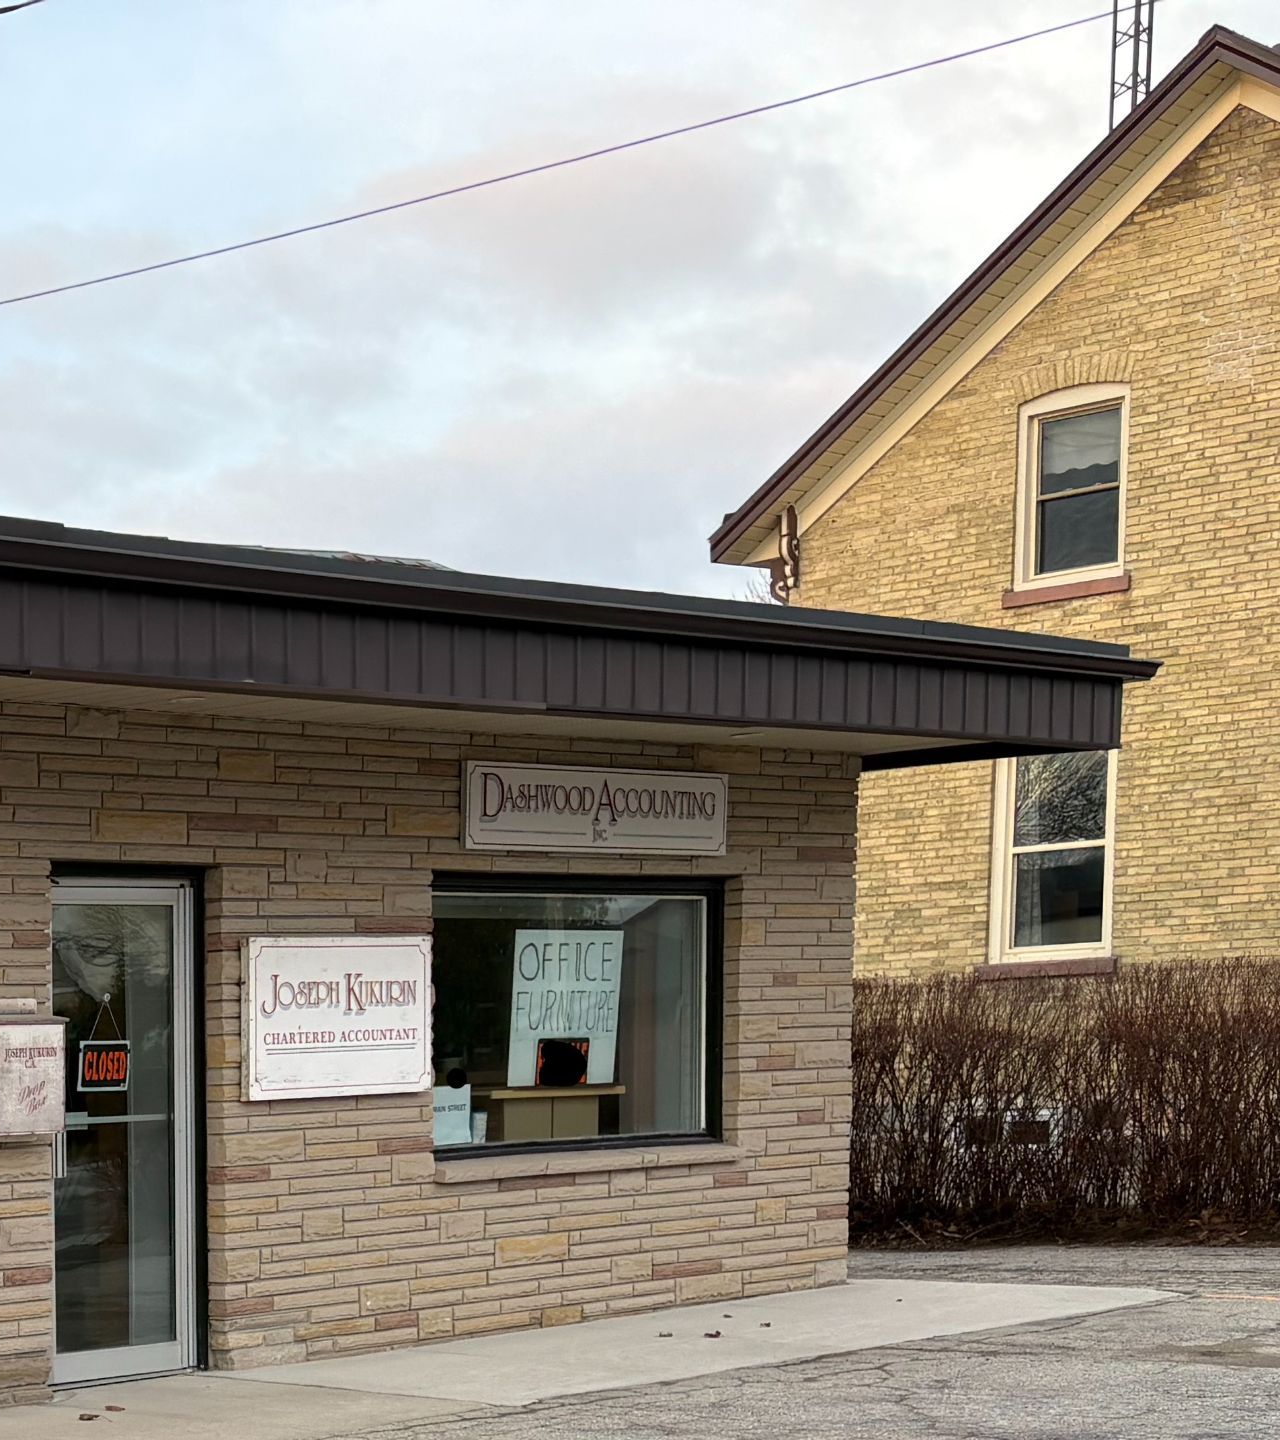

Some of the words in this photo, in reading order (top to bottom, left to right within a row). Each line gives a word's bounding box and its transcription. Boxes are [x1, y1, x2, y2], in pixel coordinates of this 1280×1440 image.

[479, 771, 595, 823] DASHWOOD
[592, 779, 716, 825] ACCOUNTING
[519, 941, 614, 982] OFFICE
[260, 973, 340, 1018] JOSEPH
[343, 973, 418, 1016] KUKURIN
[516, 990, 616, 1033] FURNITURE
[4, 1047, 28, 1062] JOSEPH
[263, 1030, 336, 1046] CHARTERED
[339, 1028, 418, 1043] ACCOUNTANT
[84, 1051, 127, 1081] CLOSED
[447, 1104, 467, 1112] STREET
